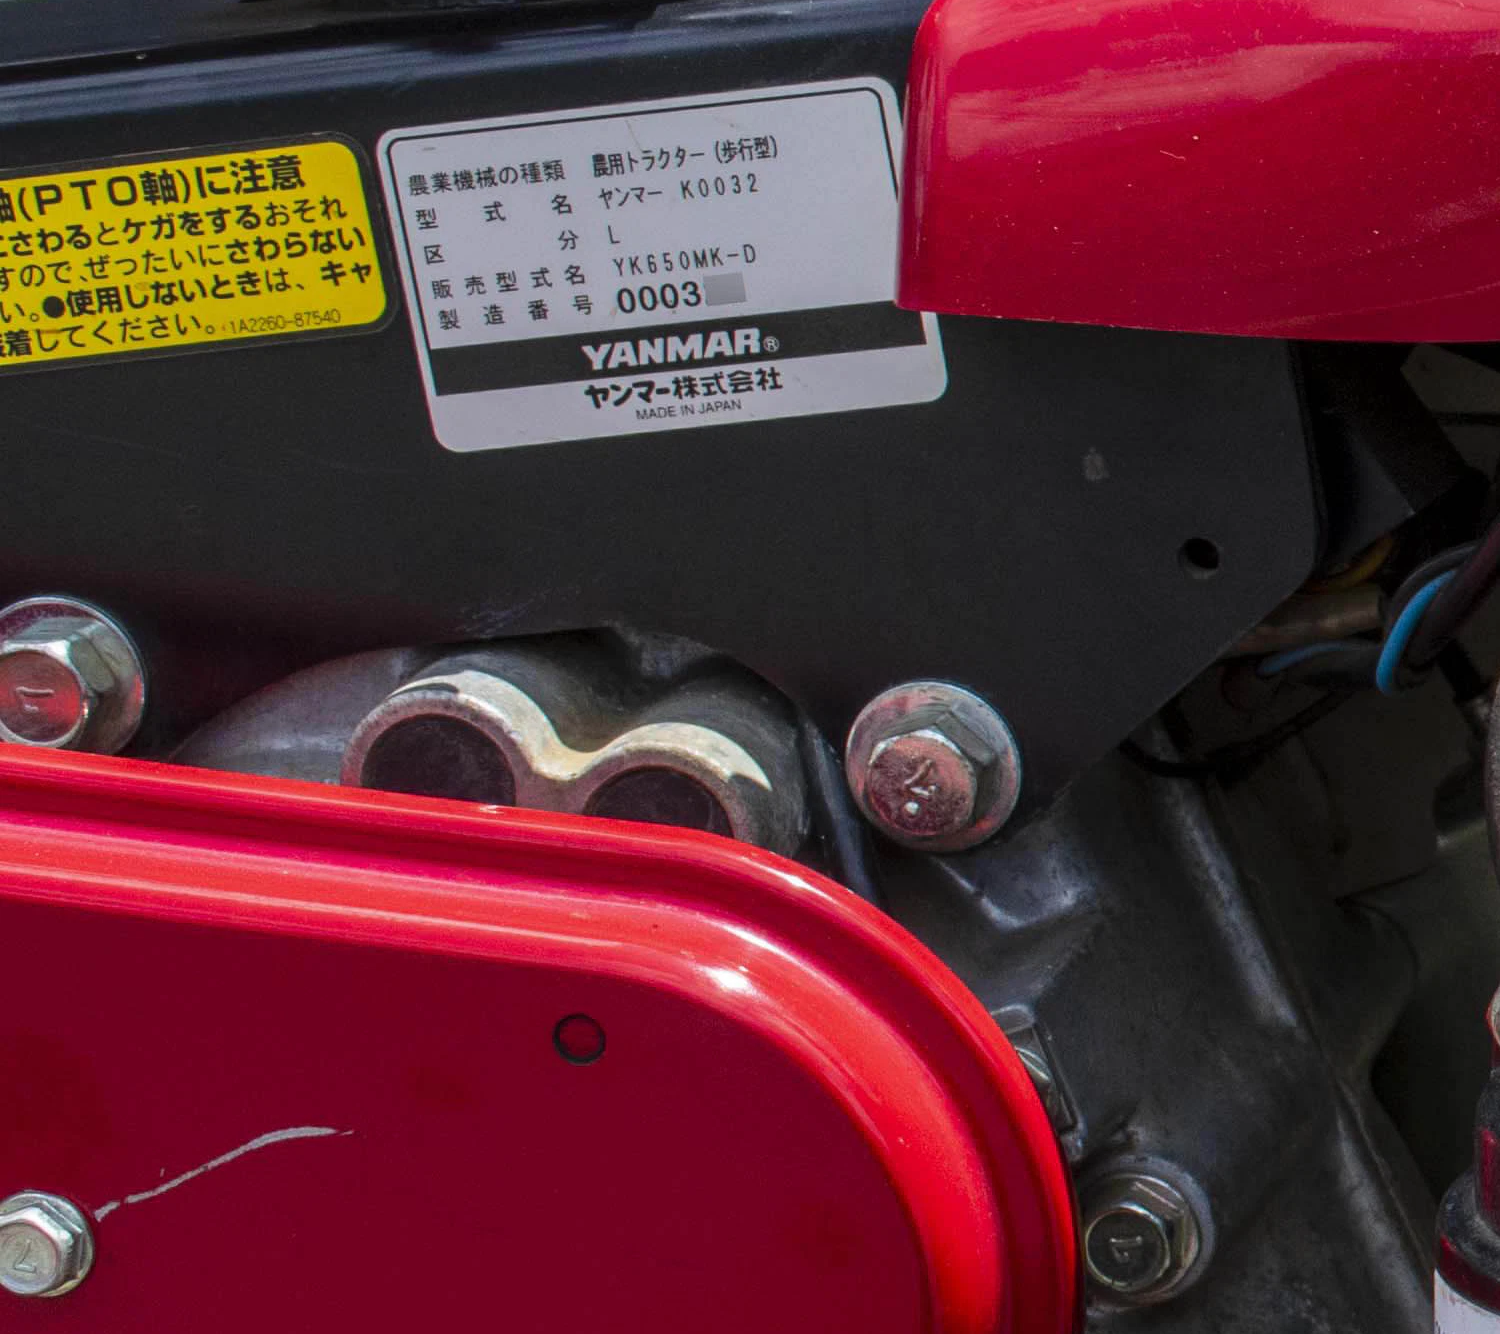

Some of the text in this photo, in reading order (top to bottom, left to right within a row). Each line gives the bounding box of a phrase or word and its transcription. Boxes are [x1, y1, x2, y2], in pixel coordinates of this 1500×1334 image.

[409, 159, 567, 196] 農業機械の種類
[598, 186, 663, 210] ヤンマー
[679, 173, 761, 199] K0032
[608, 225, 620, 246] L
[613, 244, 758, 277] YK650MK-D
[0, 312, 217, 359] 着してください。
[583, 366, 784, 410] ヤンマー株式会社
[636, 398, 742, 421] MADE IN JAPAN
